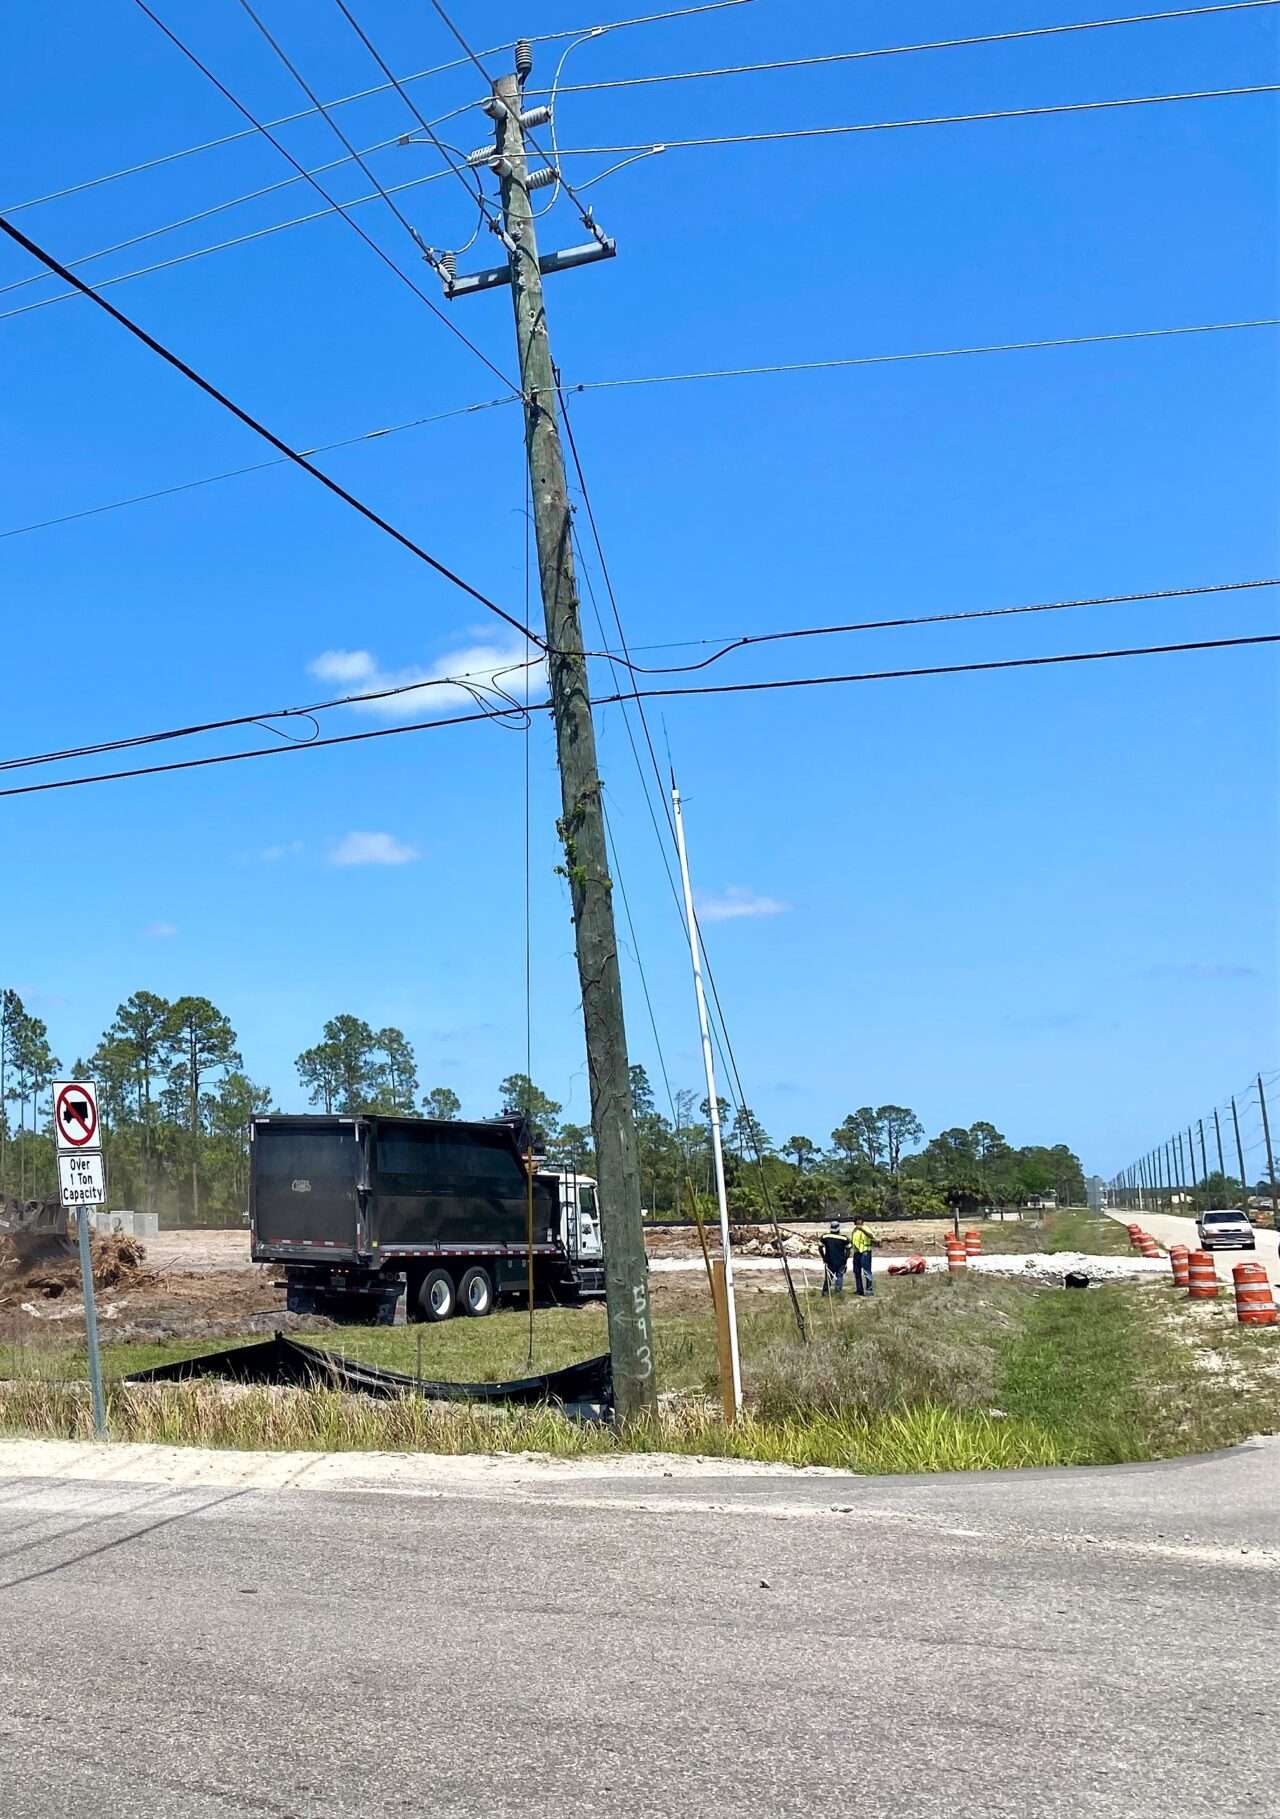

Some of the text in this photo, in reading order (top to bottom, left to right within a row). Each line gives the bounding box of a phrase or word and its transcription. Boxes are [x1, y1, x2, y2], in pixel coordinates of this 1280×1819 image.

[70, 1158, 91, 1171] Over
[70, 1172, 93, 1185] 1 Ton
[63, 1186, 103, 1203] Capacity
